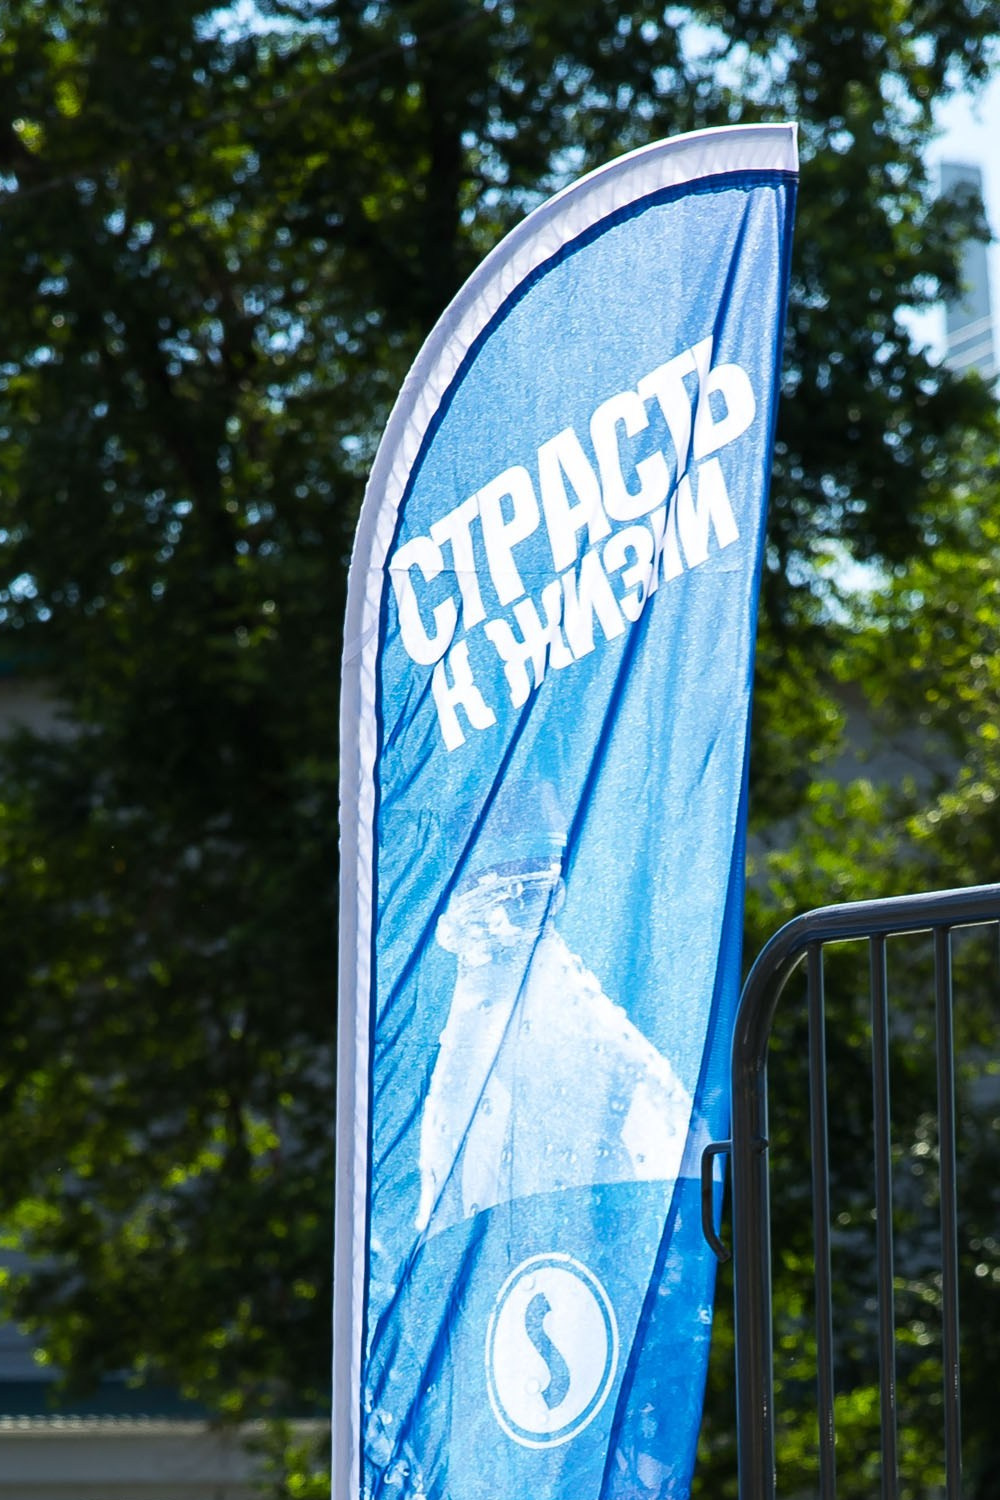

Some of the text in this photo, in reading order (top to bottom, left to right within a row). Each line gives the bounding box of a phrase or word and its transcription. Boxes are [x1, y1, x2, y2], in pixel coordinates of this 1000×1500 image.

[389, 335, 756, 666] СТРАСТЬ
[432, 457, 740, 752] К ЖИЗНИ
